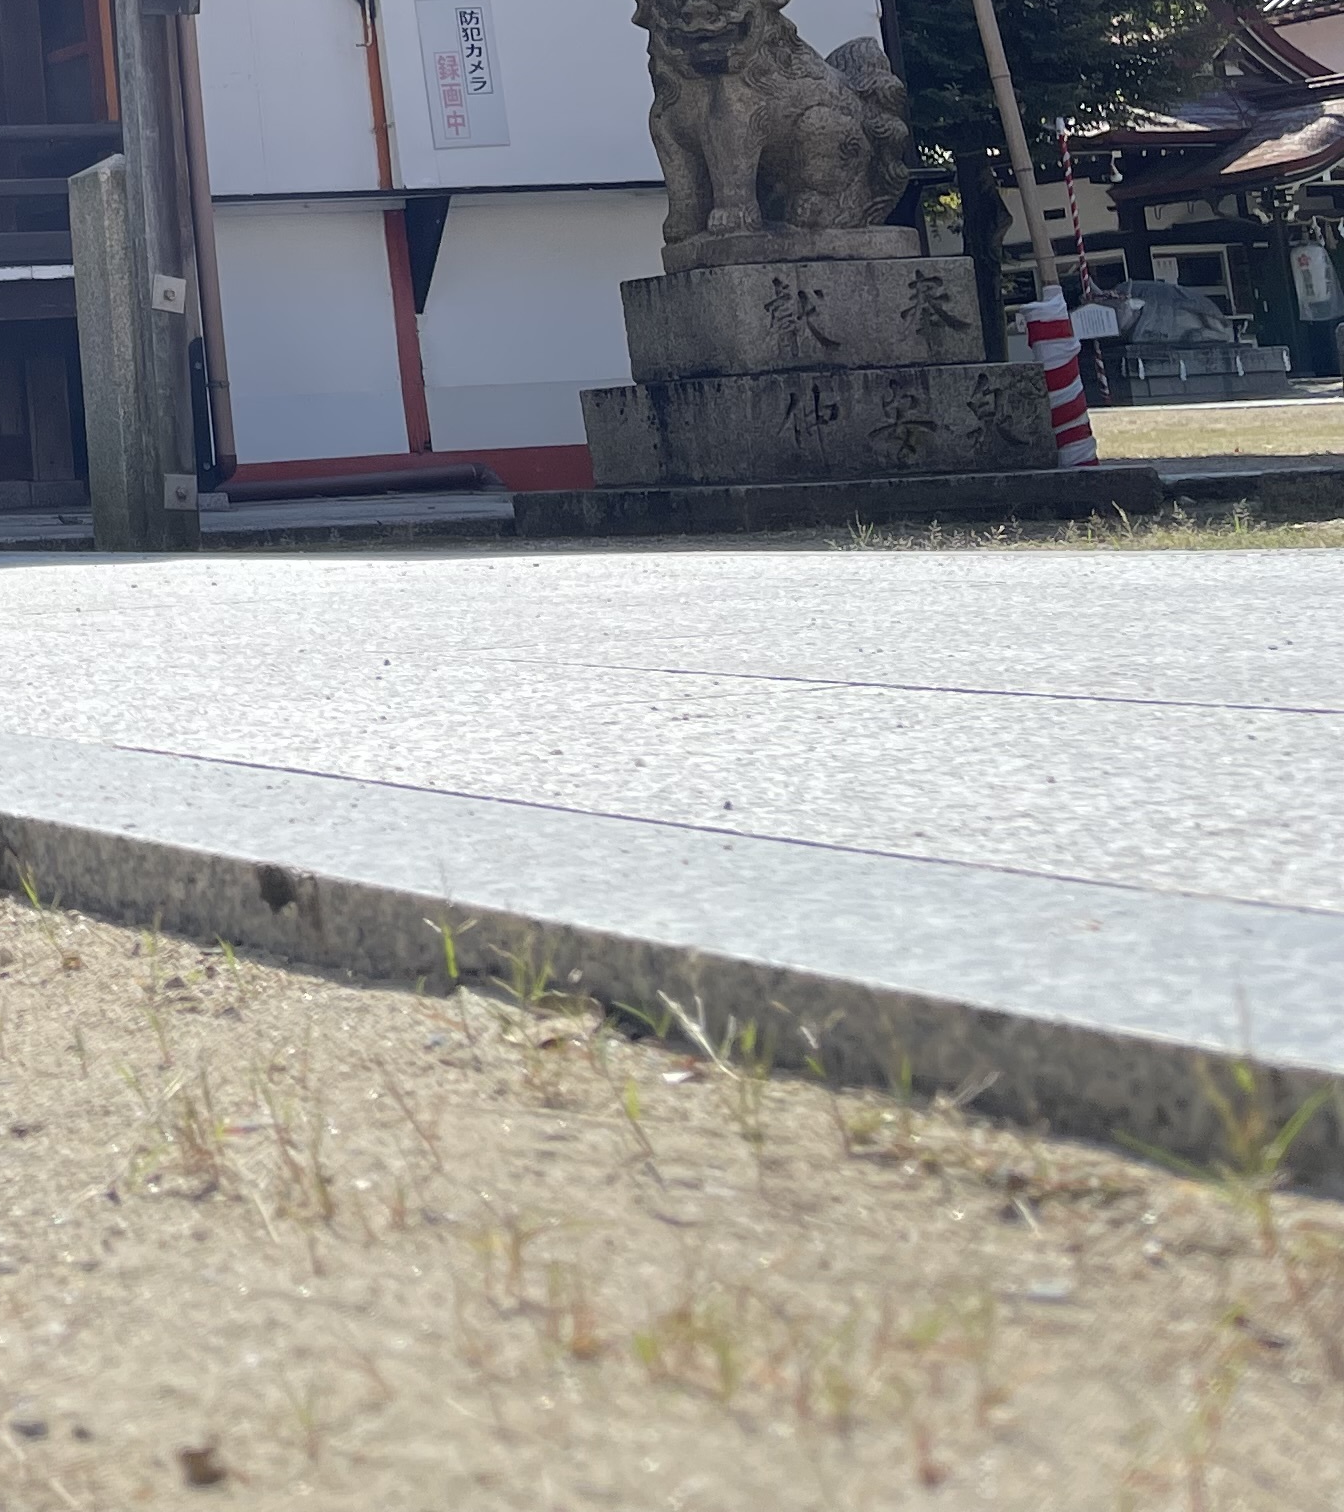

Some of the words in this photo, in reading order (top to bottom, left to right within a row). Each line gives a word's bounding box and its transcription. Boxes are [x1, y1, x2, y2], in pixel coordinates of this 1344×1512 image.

[458, 9, 487, 92] 防犯カメラ
[437, 55, 466, 136] 録画中
